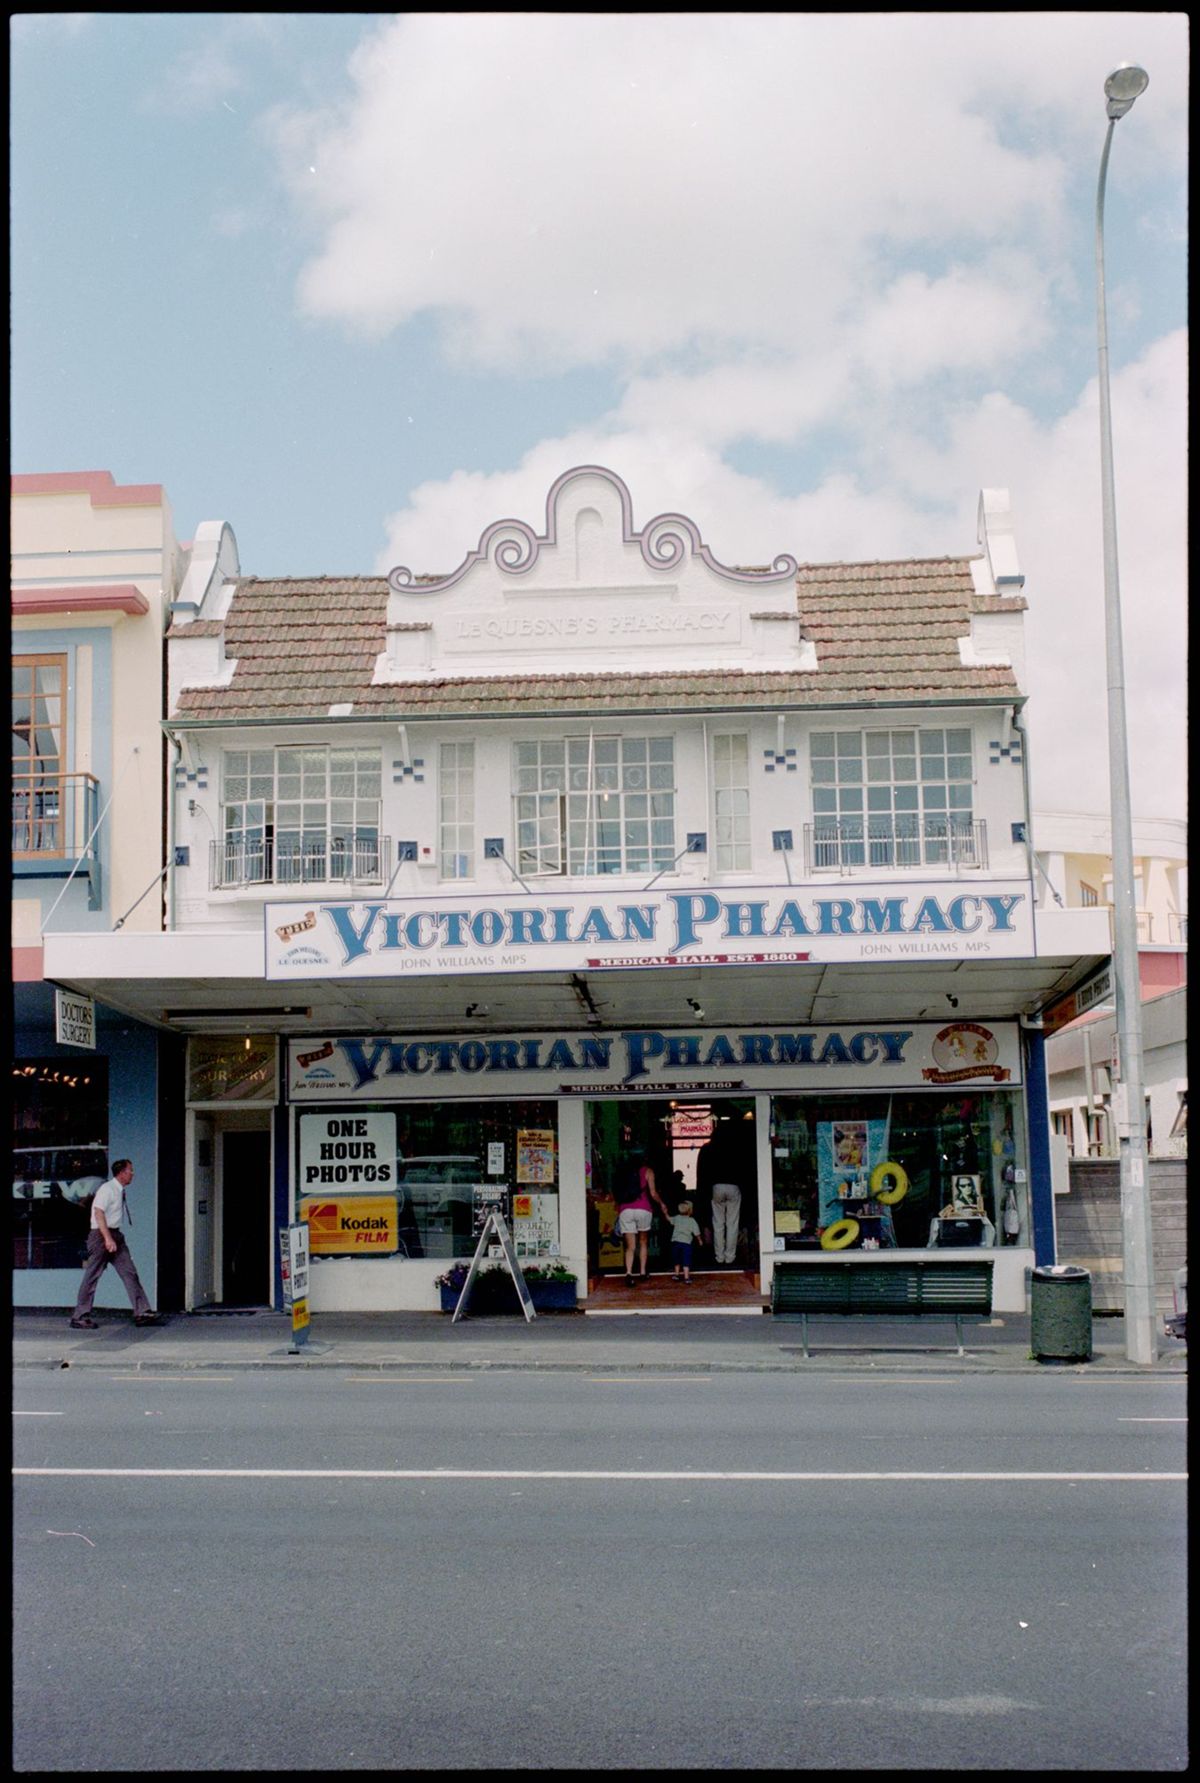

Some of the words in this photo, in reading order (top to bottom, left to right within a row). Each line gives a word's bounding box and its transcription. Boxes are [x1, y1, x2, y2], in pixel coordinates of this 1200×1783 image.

[608, 611, 731, 634] PHARMACY
[280, 919, 314, 935] THE
[320, 903, 660, 966] VICTORIAN
[667, 891, 1025, 954] PHARMACY
[860, 944, 892, 956] JOHN
[898, 942, 959, 953] WILLIAMS
[965, 941, 991, 952] MPS
[400, 958, 431, 970] JOHN
[436, 955, 495, 967] WILLIAMS
[500, 953, 527, 965] MPS
[600, 956, 669, 966] MEDICAL
[676, 954, 719, 964] HALL
[727, 953, 756, 963] EST.
[763, 952, 798, 962] 1880
[61, 1001, 92, 1025] DOCTORS
[62, 1022, 92, 1045] SURGERY
[336, 1038, 614, 1090] VICTORIAN
[621, 1031, 913, 1084] PHARMACY
[704, 1081, 732, 1089] 1880
[327, 1120, 368, 1137] ONE
[320, 1142, 377, 1160] HOUR
[306, 1164, 391, 1183] PHOTOS
[341, 1217, 388, 1230] Kodak
[355, 1232, 389, 1244] FILM
